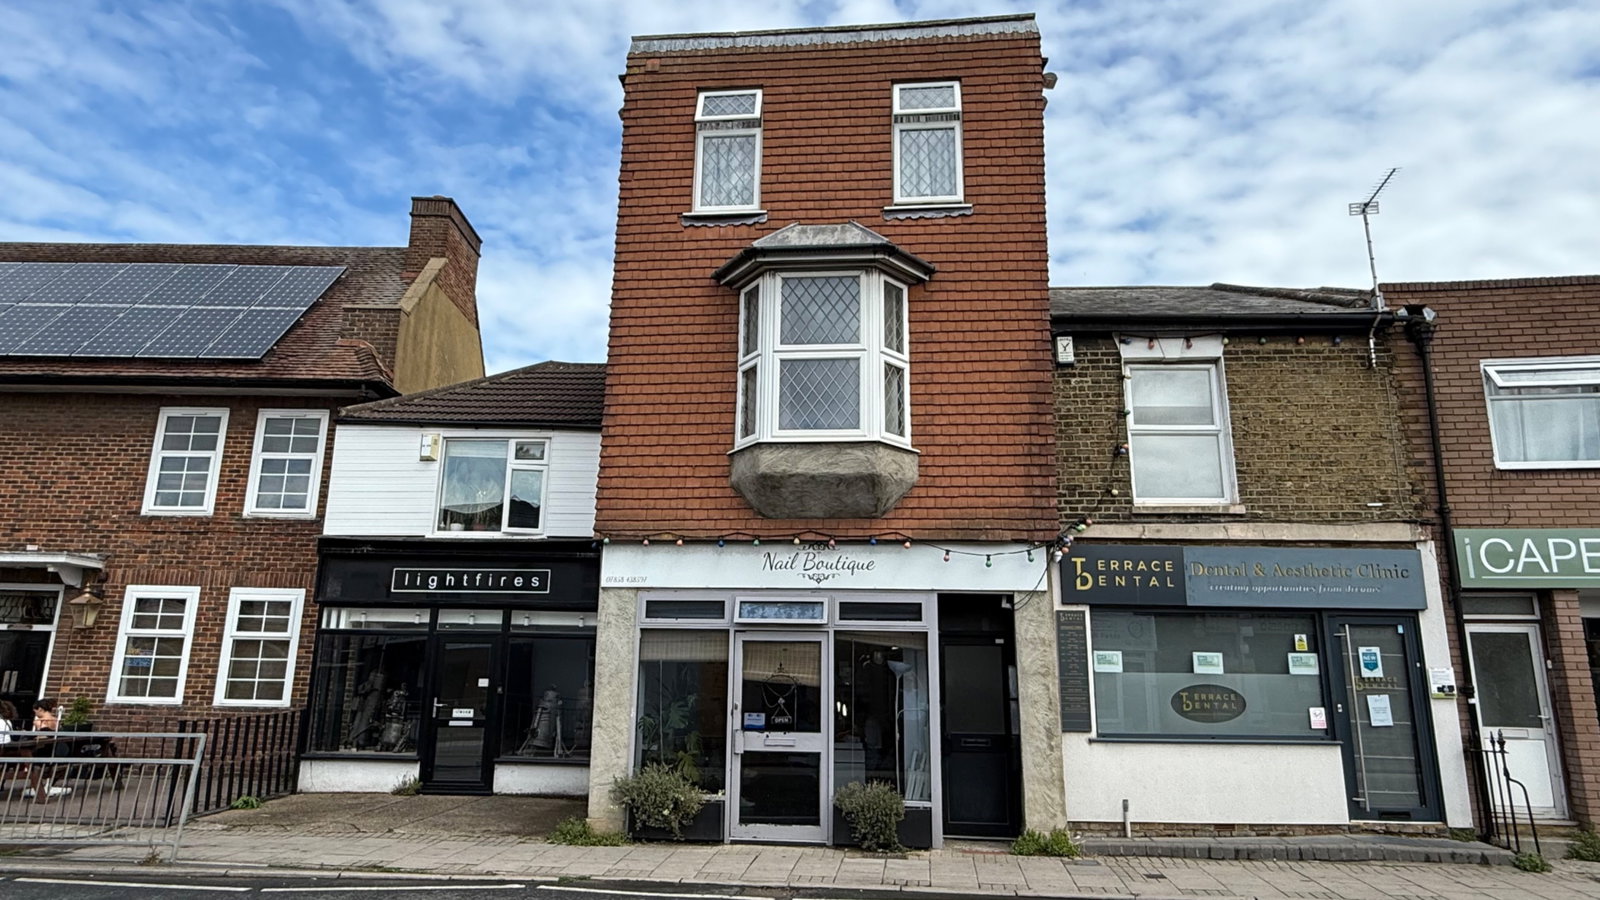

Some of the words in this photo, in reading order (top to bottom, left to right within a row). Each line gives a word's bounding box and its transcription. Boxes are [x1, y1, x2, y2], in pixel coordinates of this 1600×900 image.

[762, 551, 799, 571] Nail
[802, 551, 876, 576] Boutique
[1071, 557, 1174, 576] TERRACE
[1190, 561, 1248, 577] Dental
[1253, 561, 1266, 577] &
[1273, 562, 1353, 579] Aesthetic
[1356, 563, 1410, 579] Clinic
[404, 572, 541, 589] lightfires
[1075, 571, 1175, 590] DENTAL
[1180, 692, 1237, 703] TERRACE
[1183, 701, 1237, 711] DENTAL
